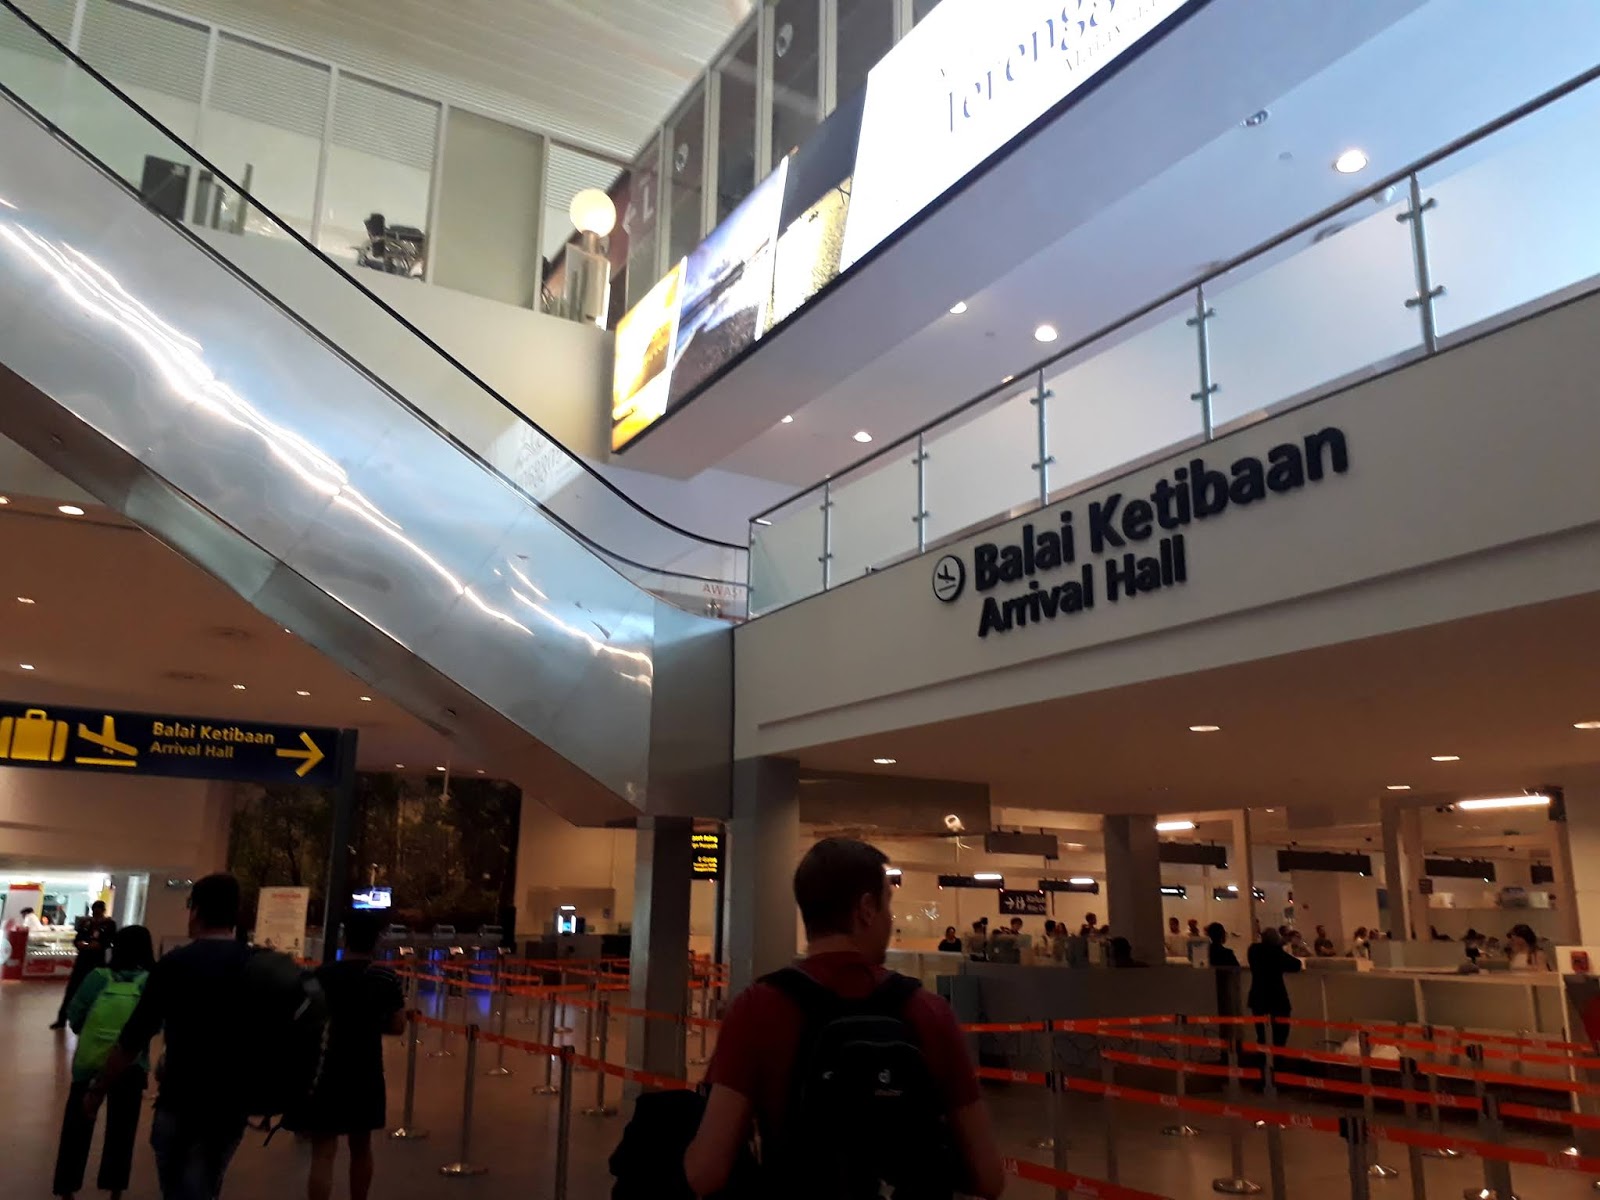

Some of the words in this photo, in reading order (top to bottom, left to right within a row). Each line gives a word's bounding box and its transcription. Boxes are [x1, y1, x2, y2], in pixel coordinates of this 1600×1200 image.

[974, 510, 1074, 592] Balai
[1088, 426, 1349, 553] Ketibaan
[977, 563, 1095, 638] Arrival
[1105, 534, 1188, 601] Hall
[150, 741, 201, 756] Arrival
[205, 744, 235, 759] Hall
[152, 721, 195, 739] Balai
[200, 725, 275, 745] Ketibaan
